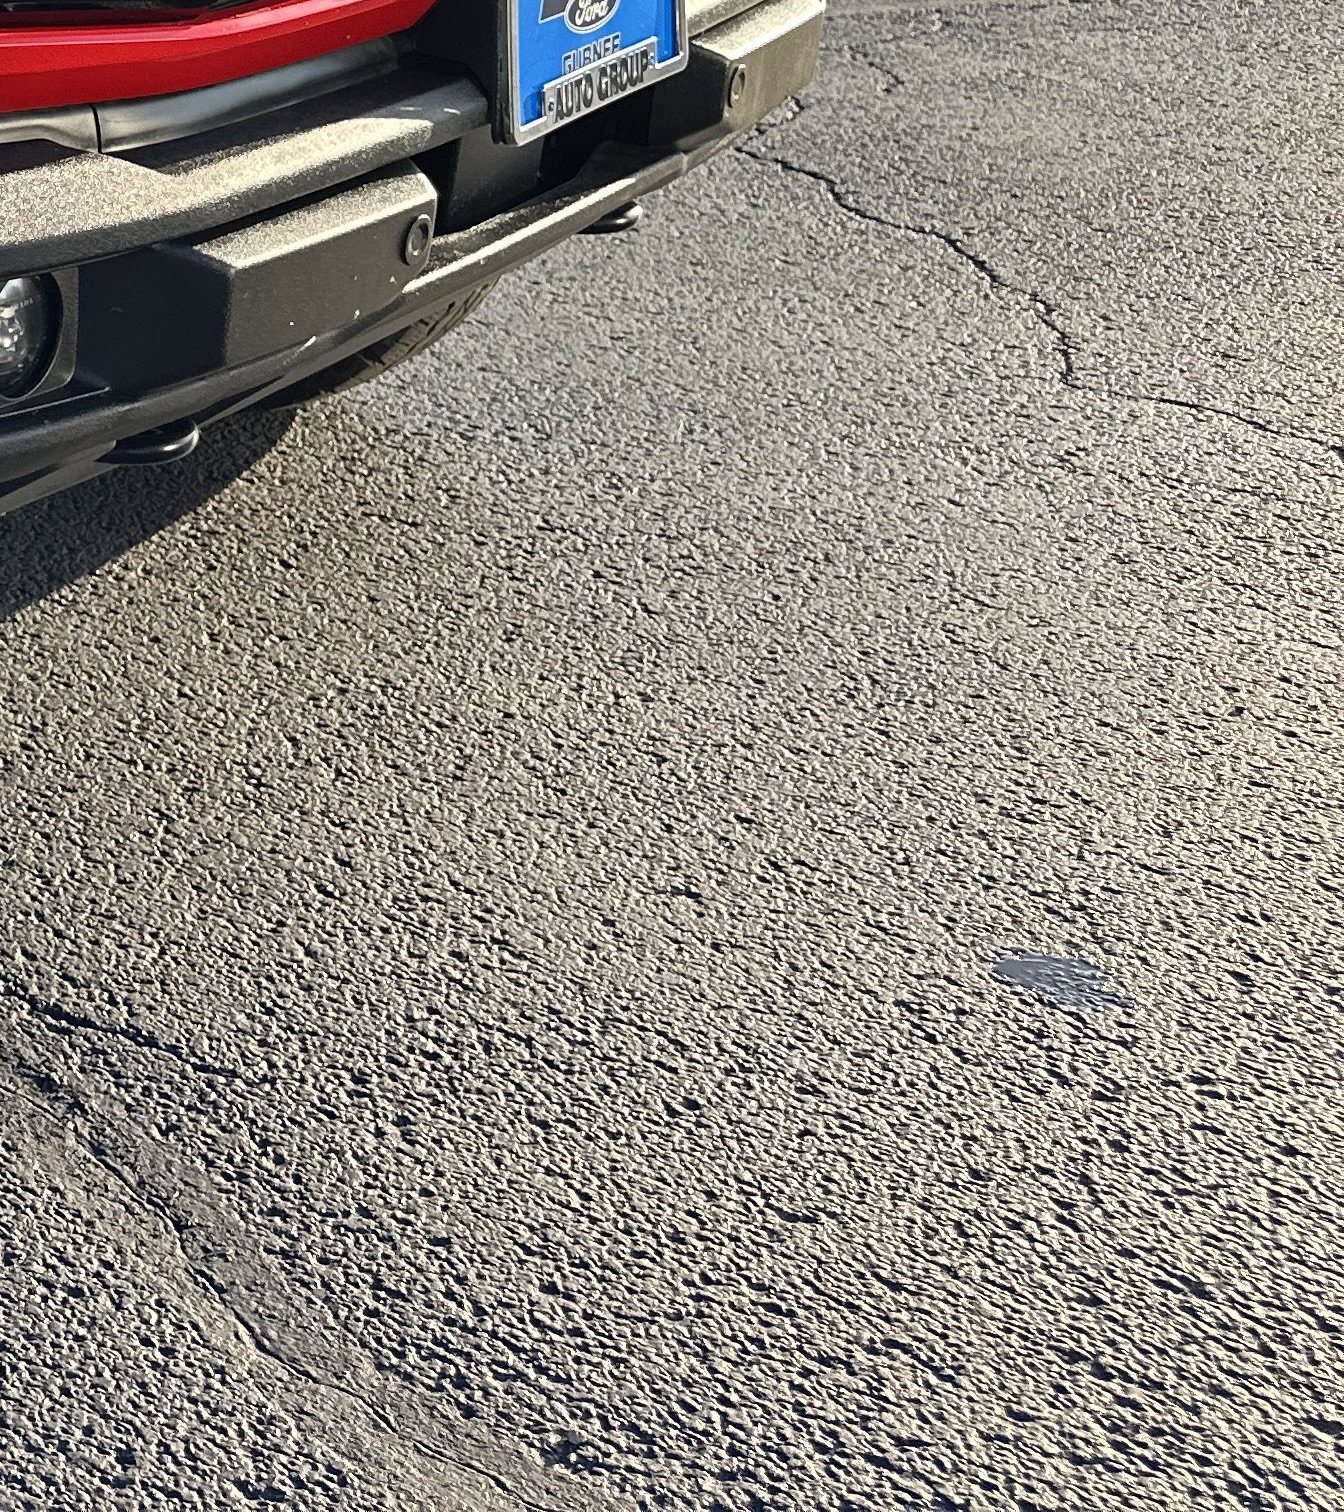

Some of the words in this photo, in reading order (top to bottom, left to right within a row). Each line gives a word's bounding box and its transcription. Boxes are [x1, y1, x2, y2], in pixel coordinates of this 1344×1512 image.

[562, 33, 621, 76] GURNEE
[554, 72, 593, 123] AUTO
[597, 48, 649, 101] GROUP
